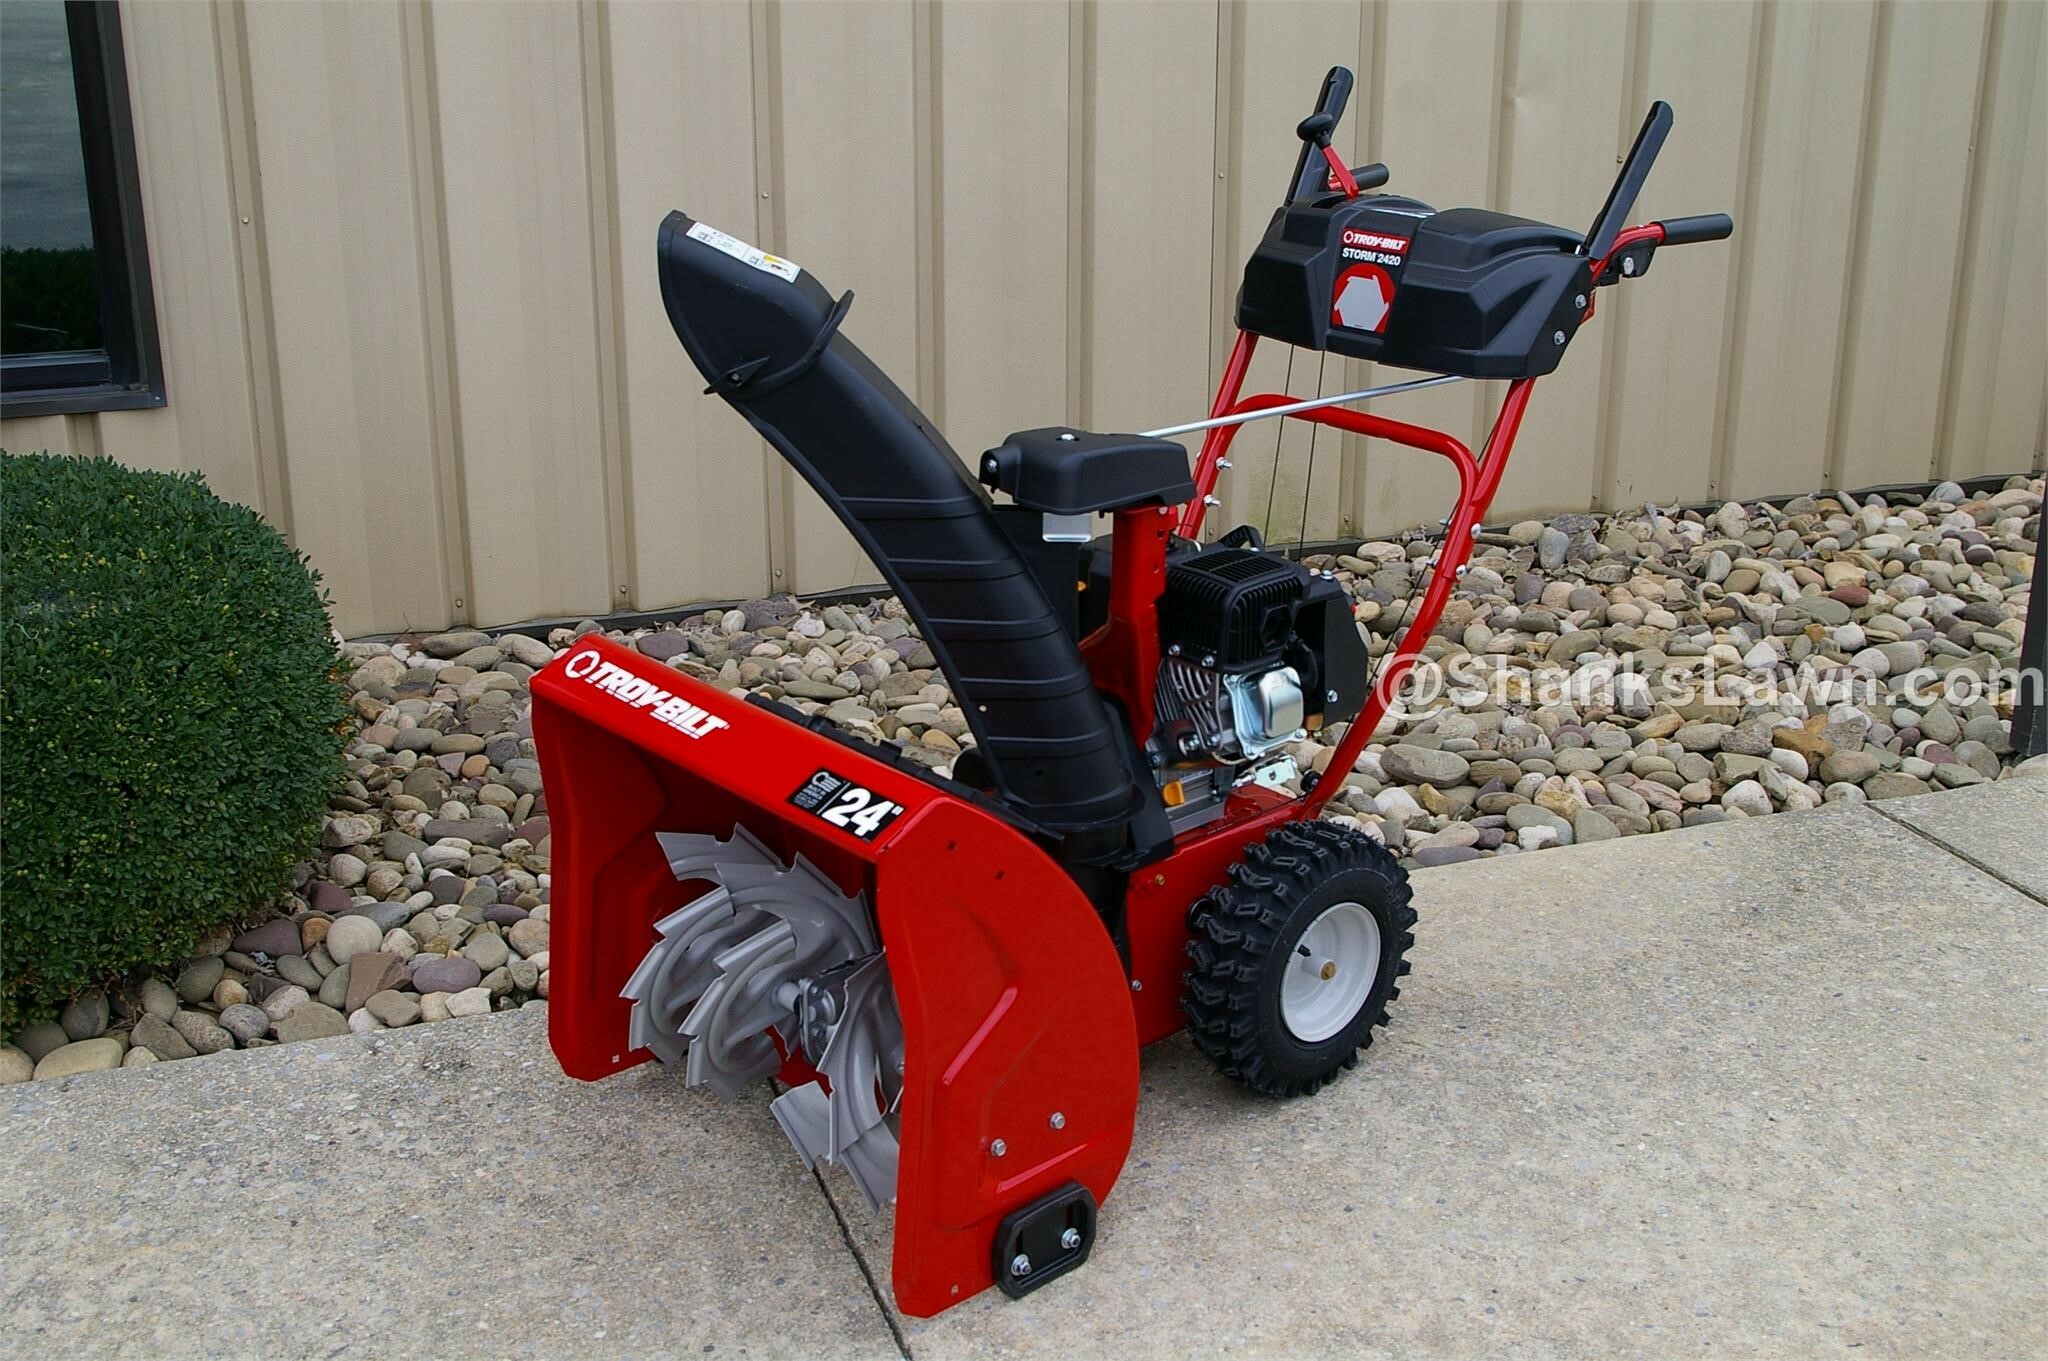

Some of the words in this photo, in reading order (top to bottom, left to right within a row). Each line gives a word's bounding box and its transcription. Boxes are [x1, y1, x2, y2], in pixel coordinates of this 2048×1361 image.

[1352, 234, 1406, 250] TROY-BILT
[1342, 248, 1377, 262] STORM
[1377, 253, 1401, 266] 2420
[585, 661, 730, 739] TROY-BILT
